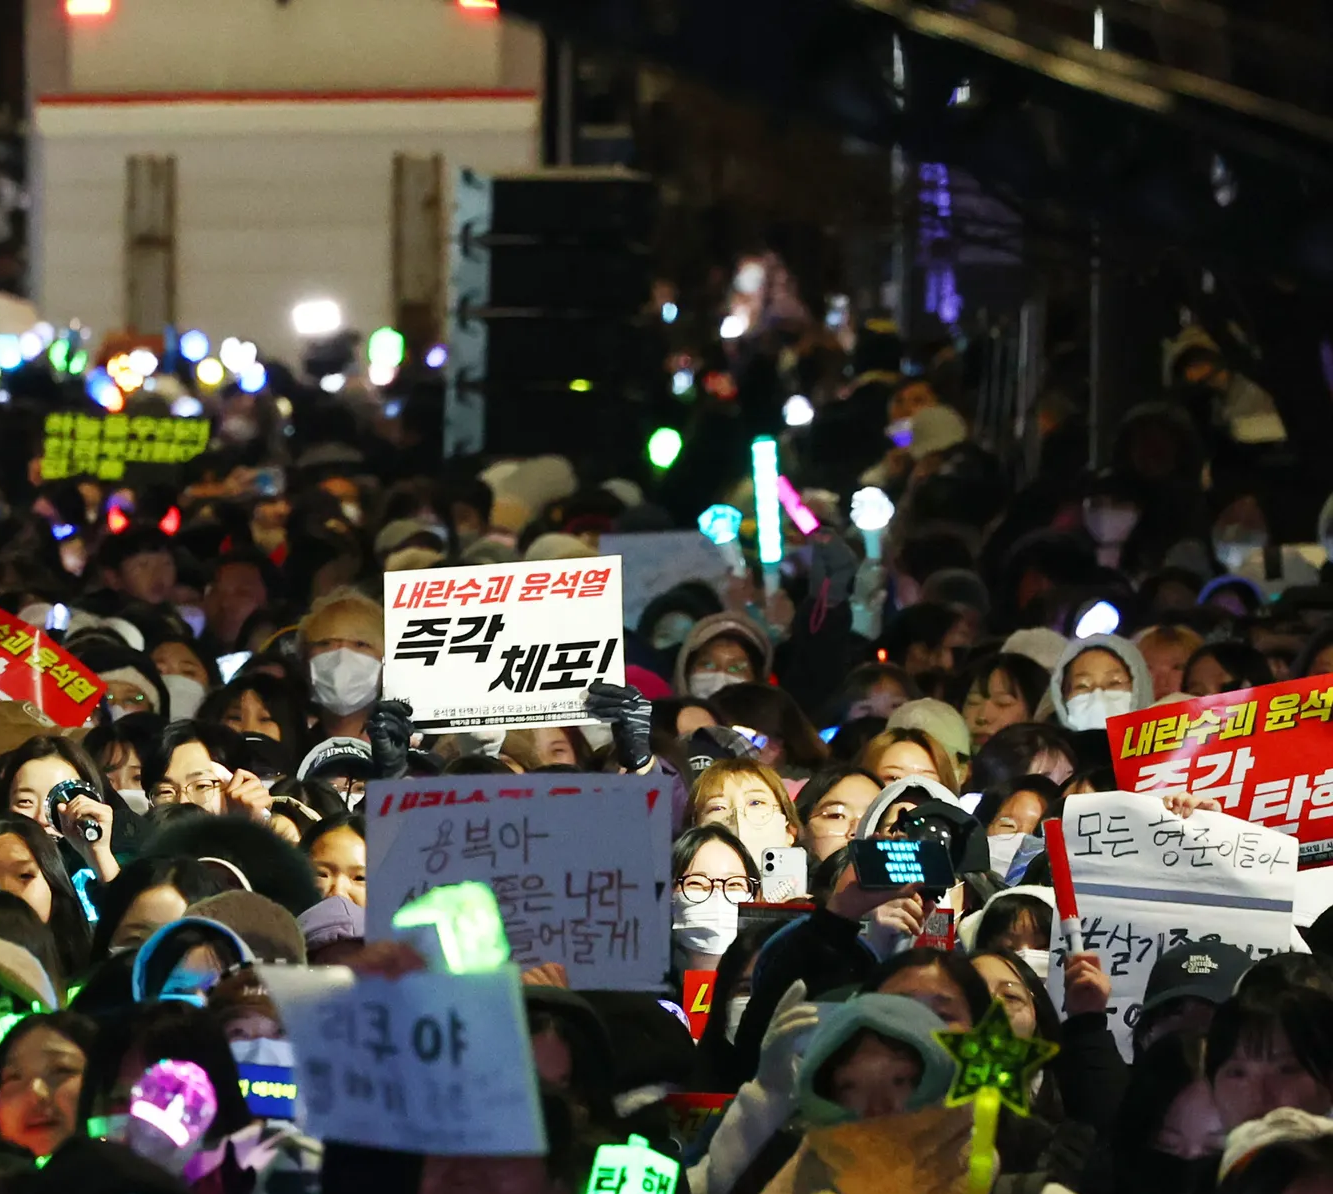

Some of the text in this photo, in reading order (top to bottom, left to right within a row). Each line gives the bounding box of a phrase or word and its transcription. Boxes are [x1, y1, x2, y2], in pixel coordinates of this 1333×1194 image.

[392, 568, 611, 610] 내란수괴 윤석열
[393, 613, 505, 667] 즉각
[487, 637, 619, 693] 체포!
[25, 646, 99, 704] 윤석열
[1120, 700, 1259, 759] 내란수괴
[419, 816, 550, 874] 용복아
[1074, 812, 1290, 875] 모든 형준이들아
[565, 868, 638, 925] 나라
